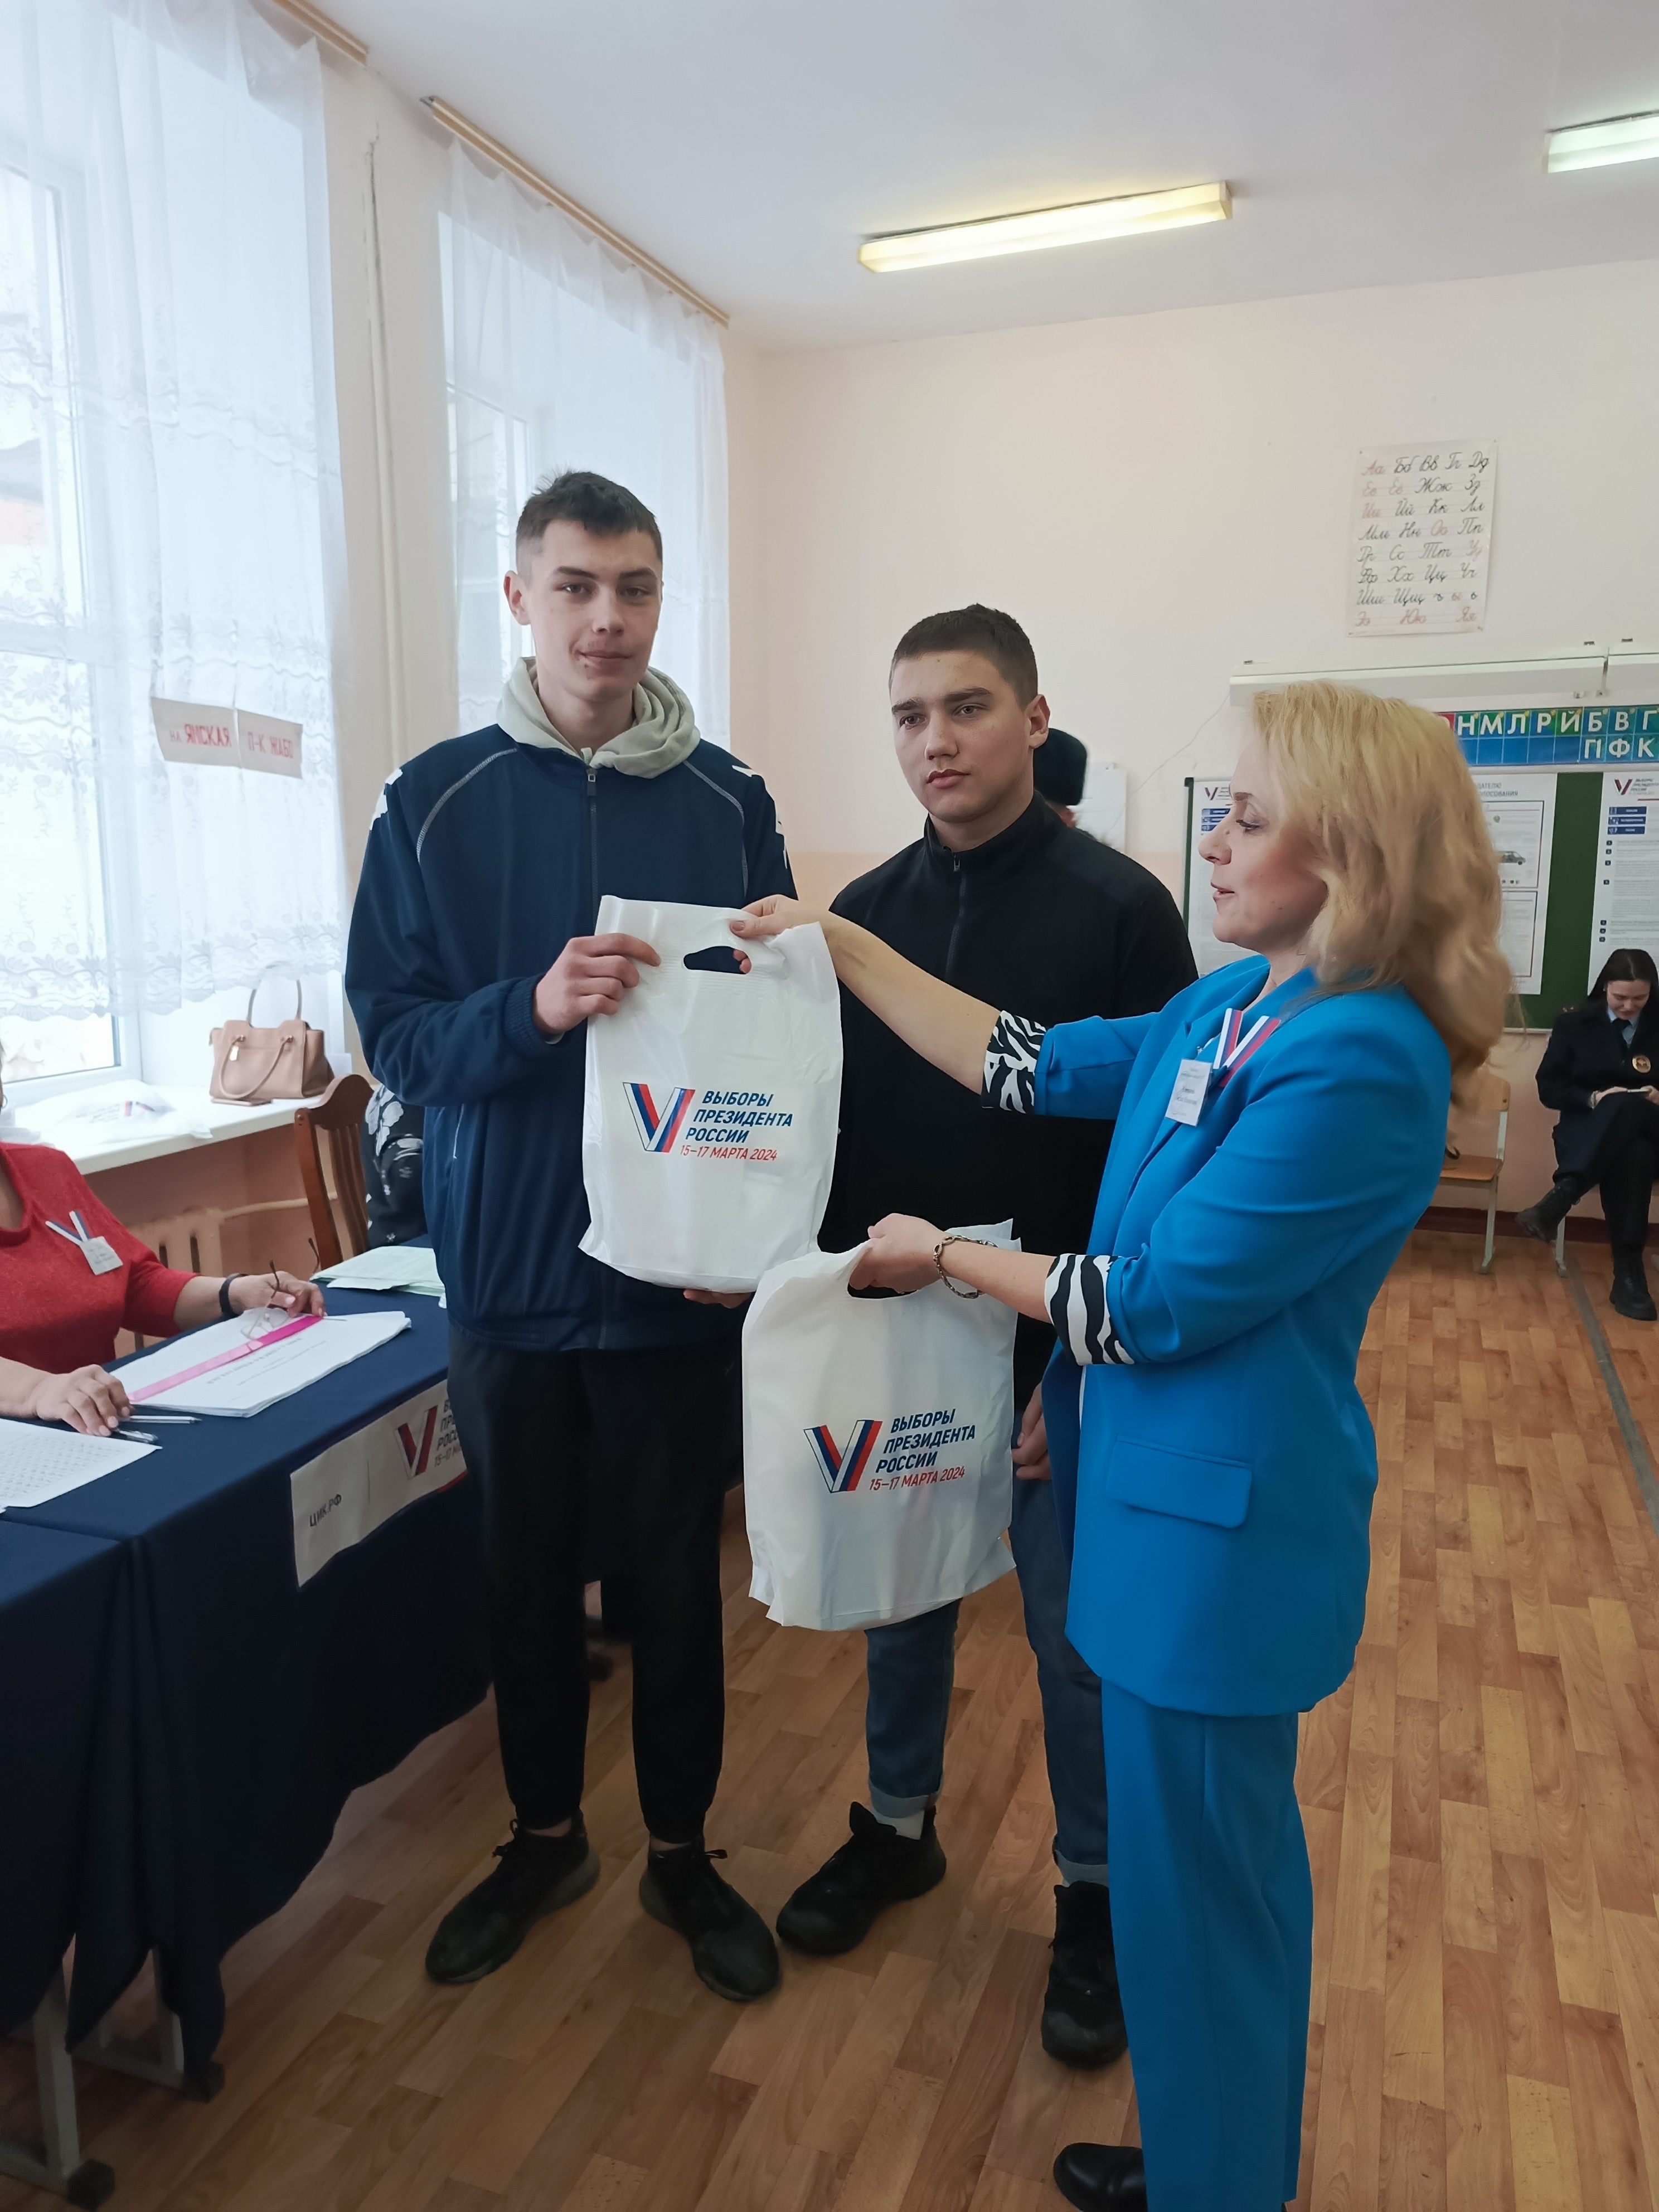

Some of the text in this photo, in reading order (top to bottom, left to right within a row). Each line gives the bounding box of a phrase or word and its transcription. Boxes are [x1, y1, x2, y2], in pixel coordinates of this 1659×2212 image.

[702, 1091, 774, 1107] ВЫБОРЫ
[693, 1109, 793, 1127] ПРЕЗИДЕНТА
[686, 1128, 749, 1143] РОССИИ
[710, 1146, 748, 1160] МАРТА
[750, 1149, 777, 1161] 2024
[891, 1409, 955, 1433] ВЫБОРЫ
[884, 1425, 975, 1453] ПРЕЗИДЕНТА
[875, 1451, 938, 1473] РОССИИ
[901, 1471, 938, 1488] МАРТА
[939, 1466, 965, 1481] 2024
[309, 1494, 342, 1527] ЦИК.РФ
